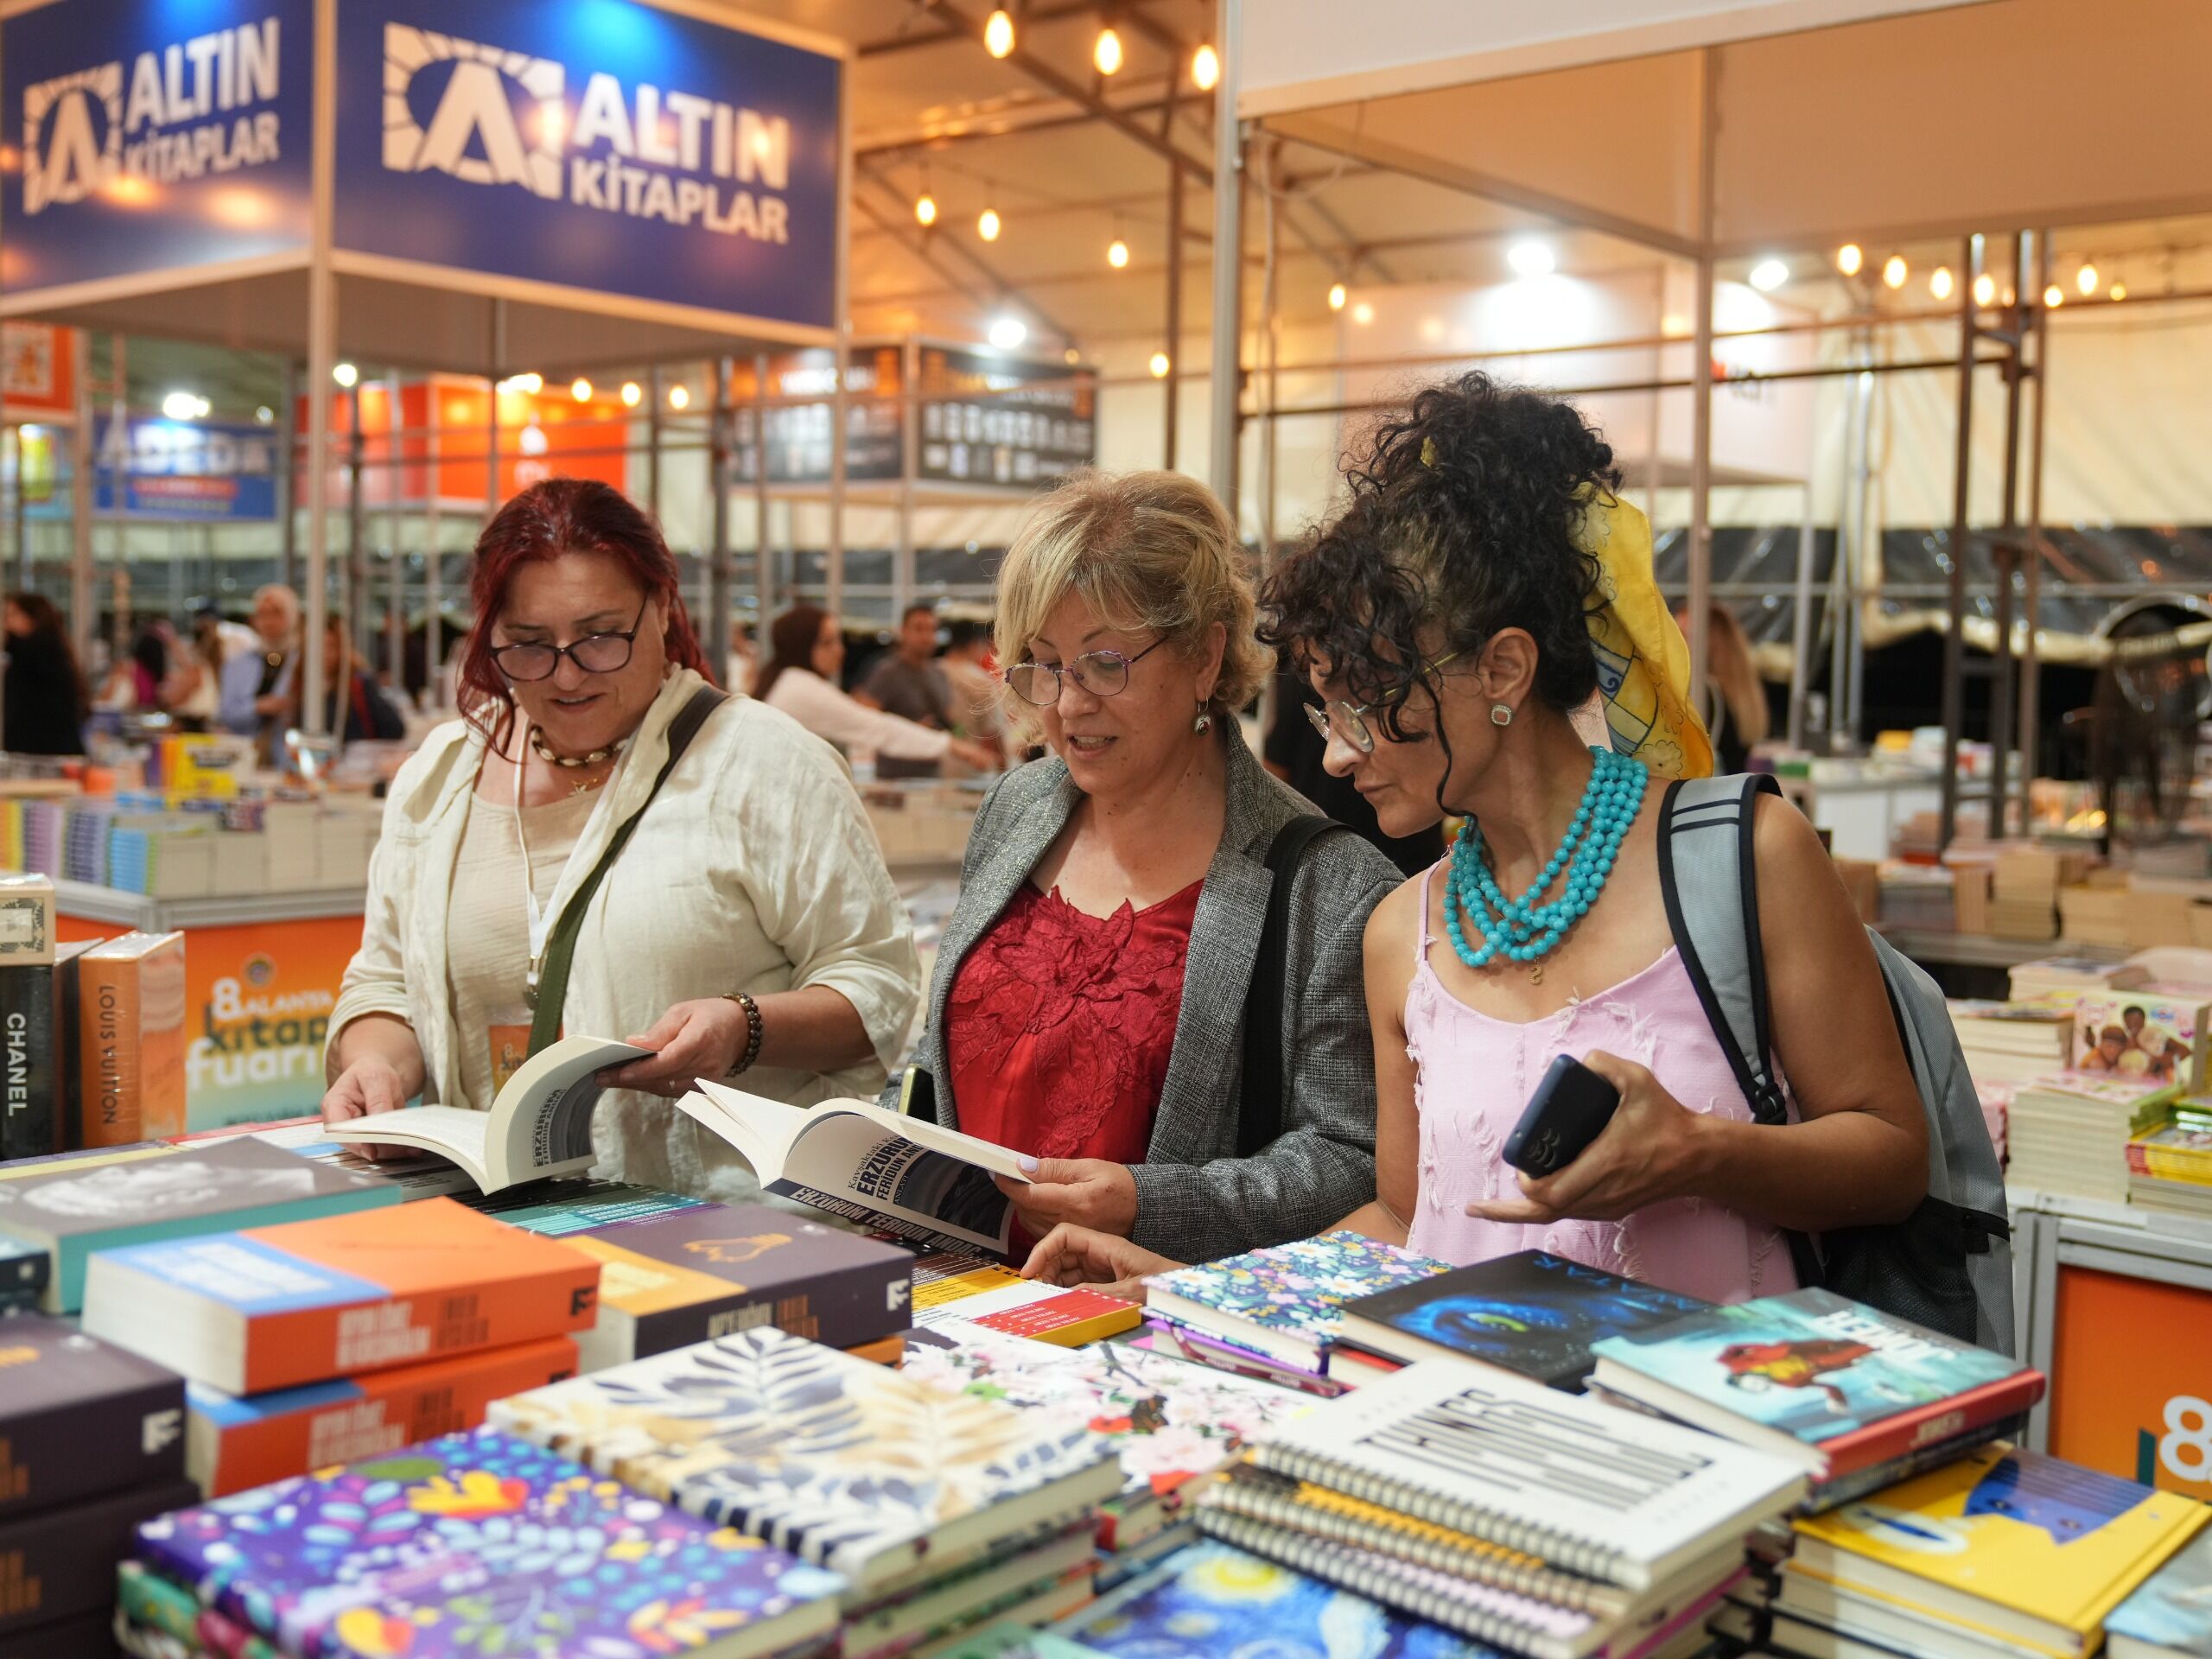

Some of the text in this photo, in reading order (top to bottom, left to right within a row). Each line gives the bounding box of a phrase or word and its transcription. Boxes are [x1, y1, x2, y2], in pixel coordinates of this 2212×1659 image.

[124, 16, 280, 134] ALTIN
[124, 110, 280, 183] KİTAPLAR
[572, 71, 791, 191] ALTIN
[570, 155, 791, 245] KİTAPLAR
[7, 1012, 28, 1117] CHANEL
[99, 985, 118, 1124] LOUIS VUITTON
[789, 1186, 868, 1222] ERZURUM
[865, 1211, 932, 1242] FERİDUN
[875, 1157, 907, 1201] FERİDUN
[2159, 1395, 2212, 1482] 8
